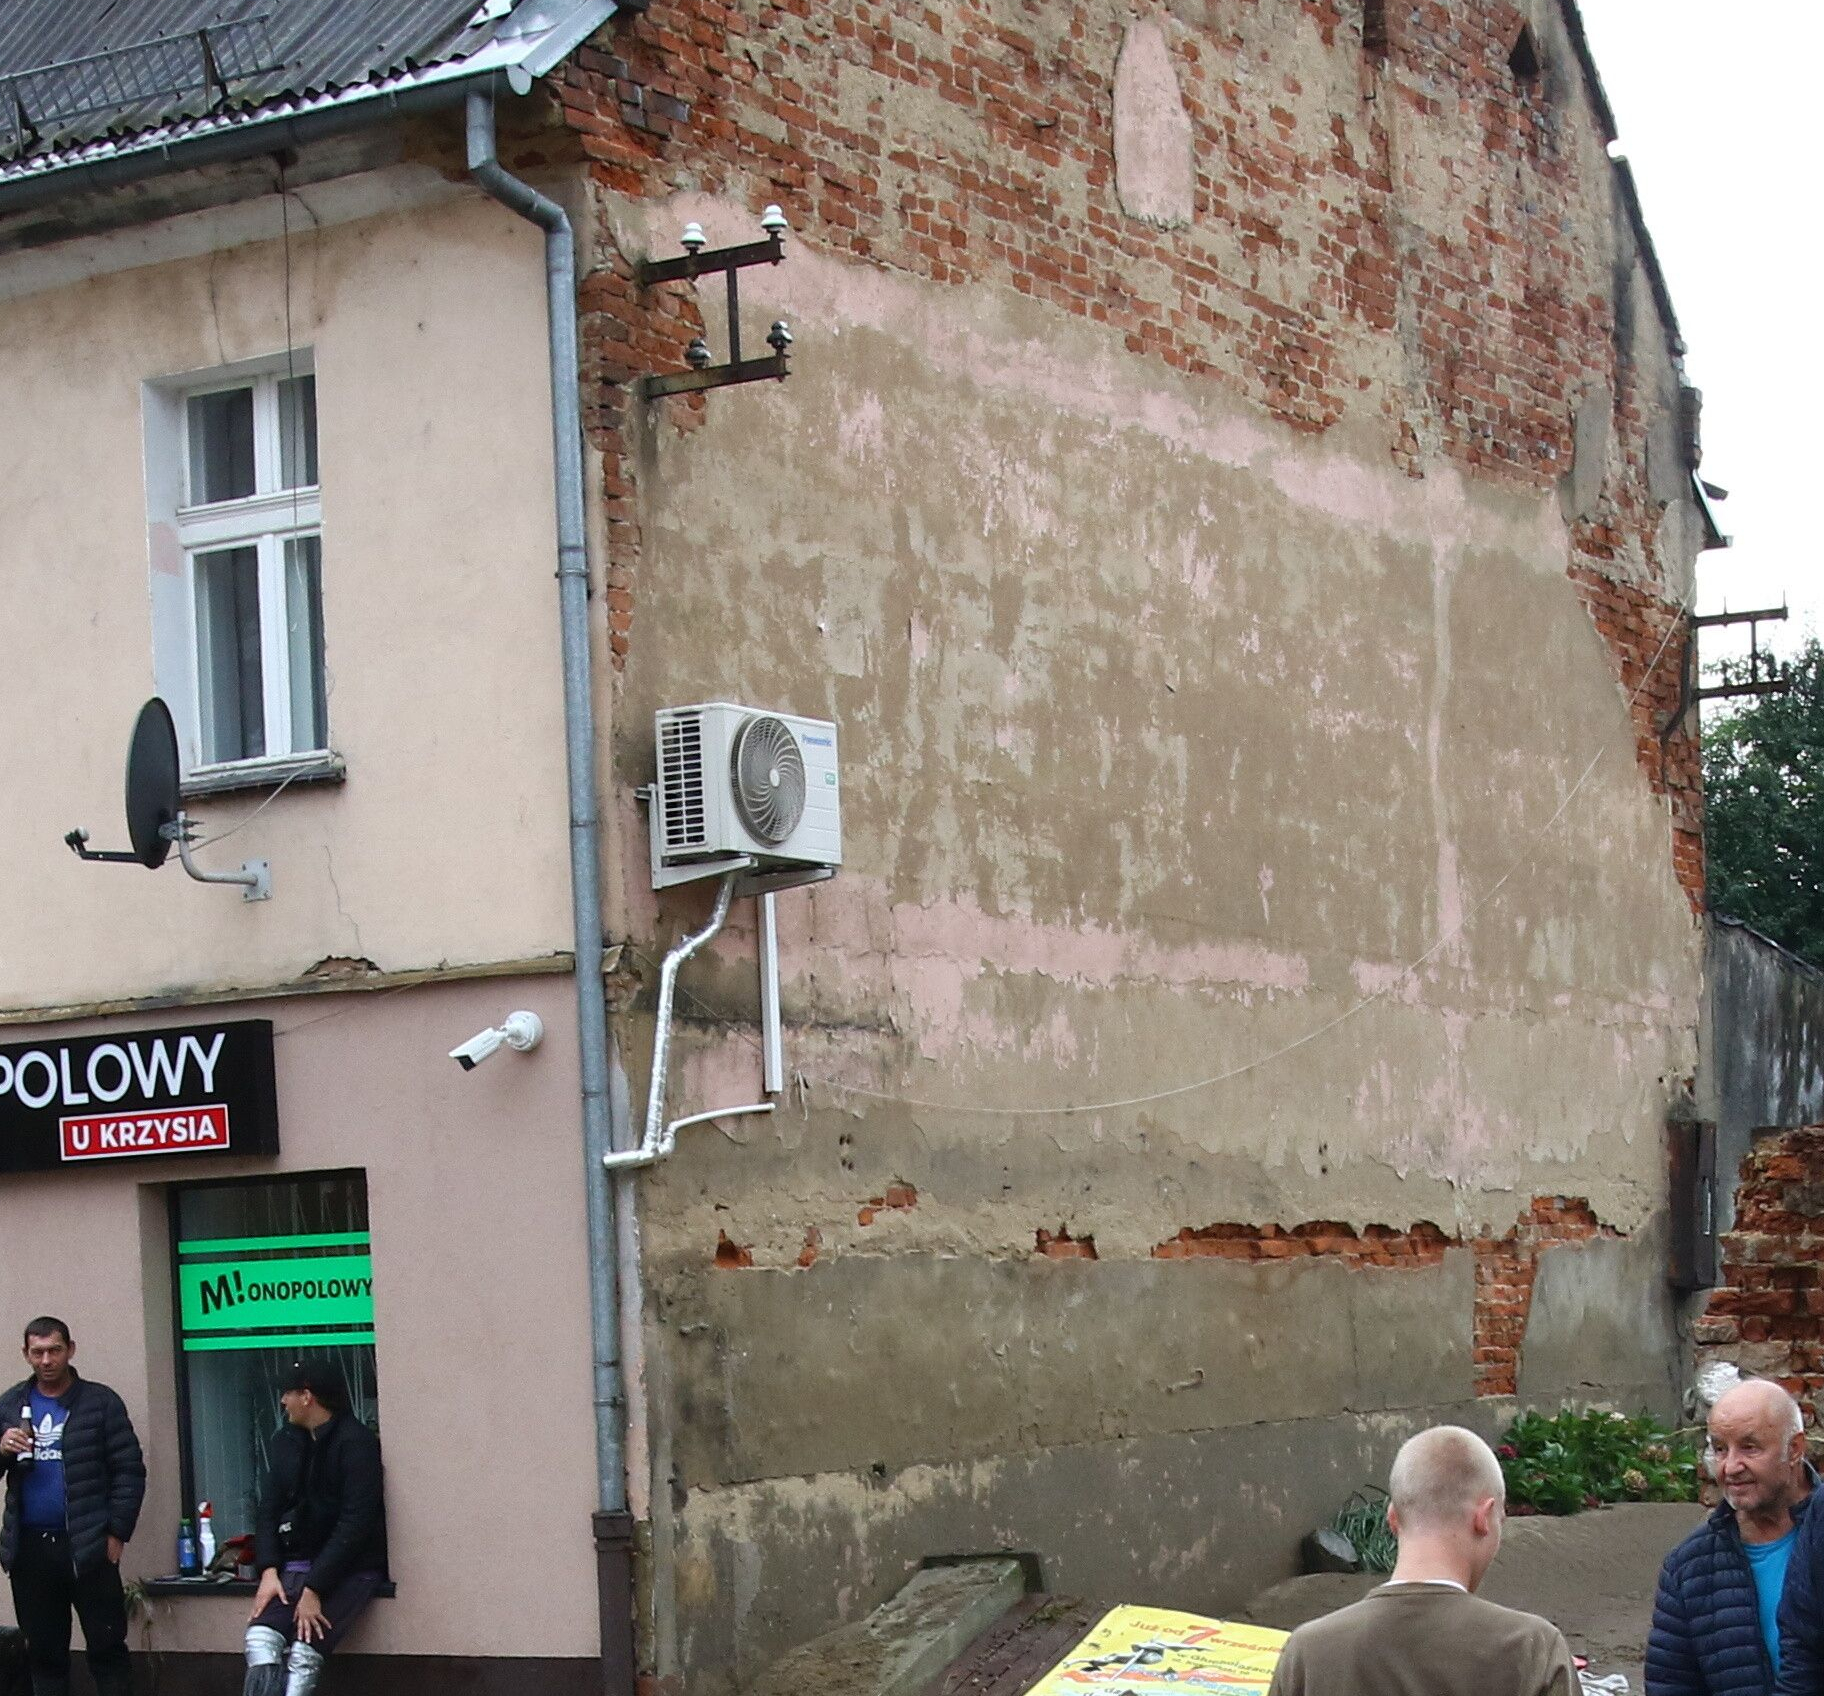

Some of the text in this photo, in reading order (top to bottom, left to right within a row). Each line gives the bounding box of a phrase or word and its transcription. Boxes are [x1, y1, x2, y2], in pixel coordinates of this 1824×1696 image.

[71, 1115, 217, 1150] U KRZYSIA
[1187, 1625, 1221, 1645] 7
